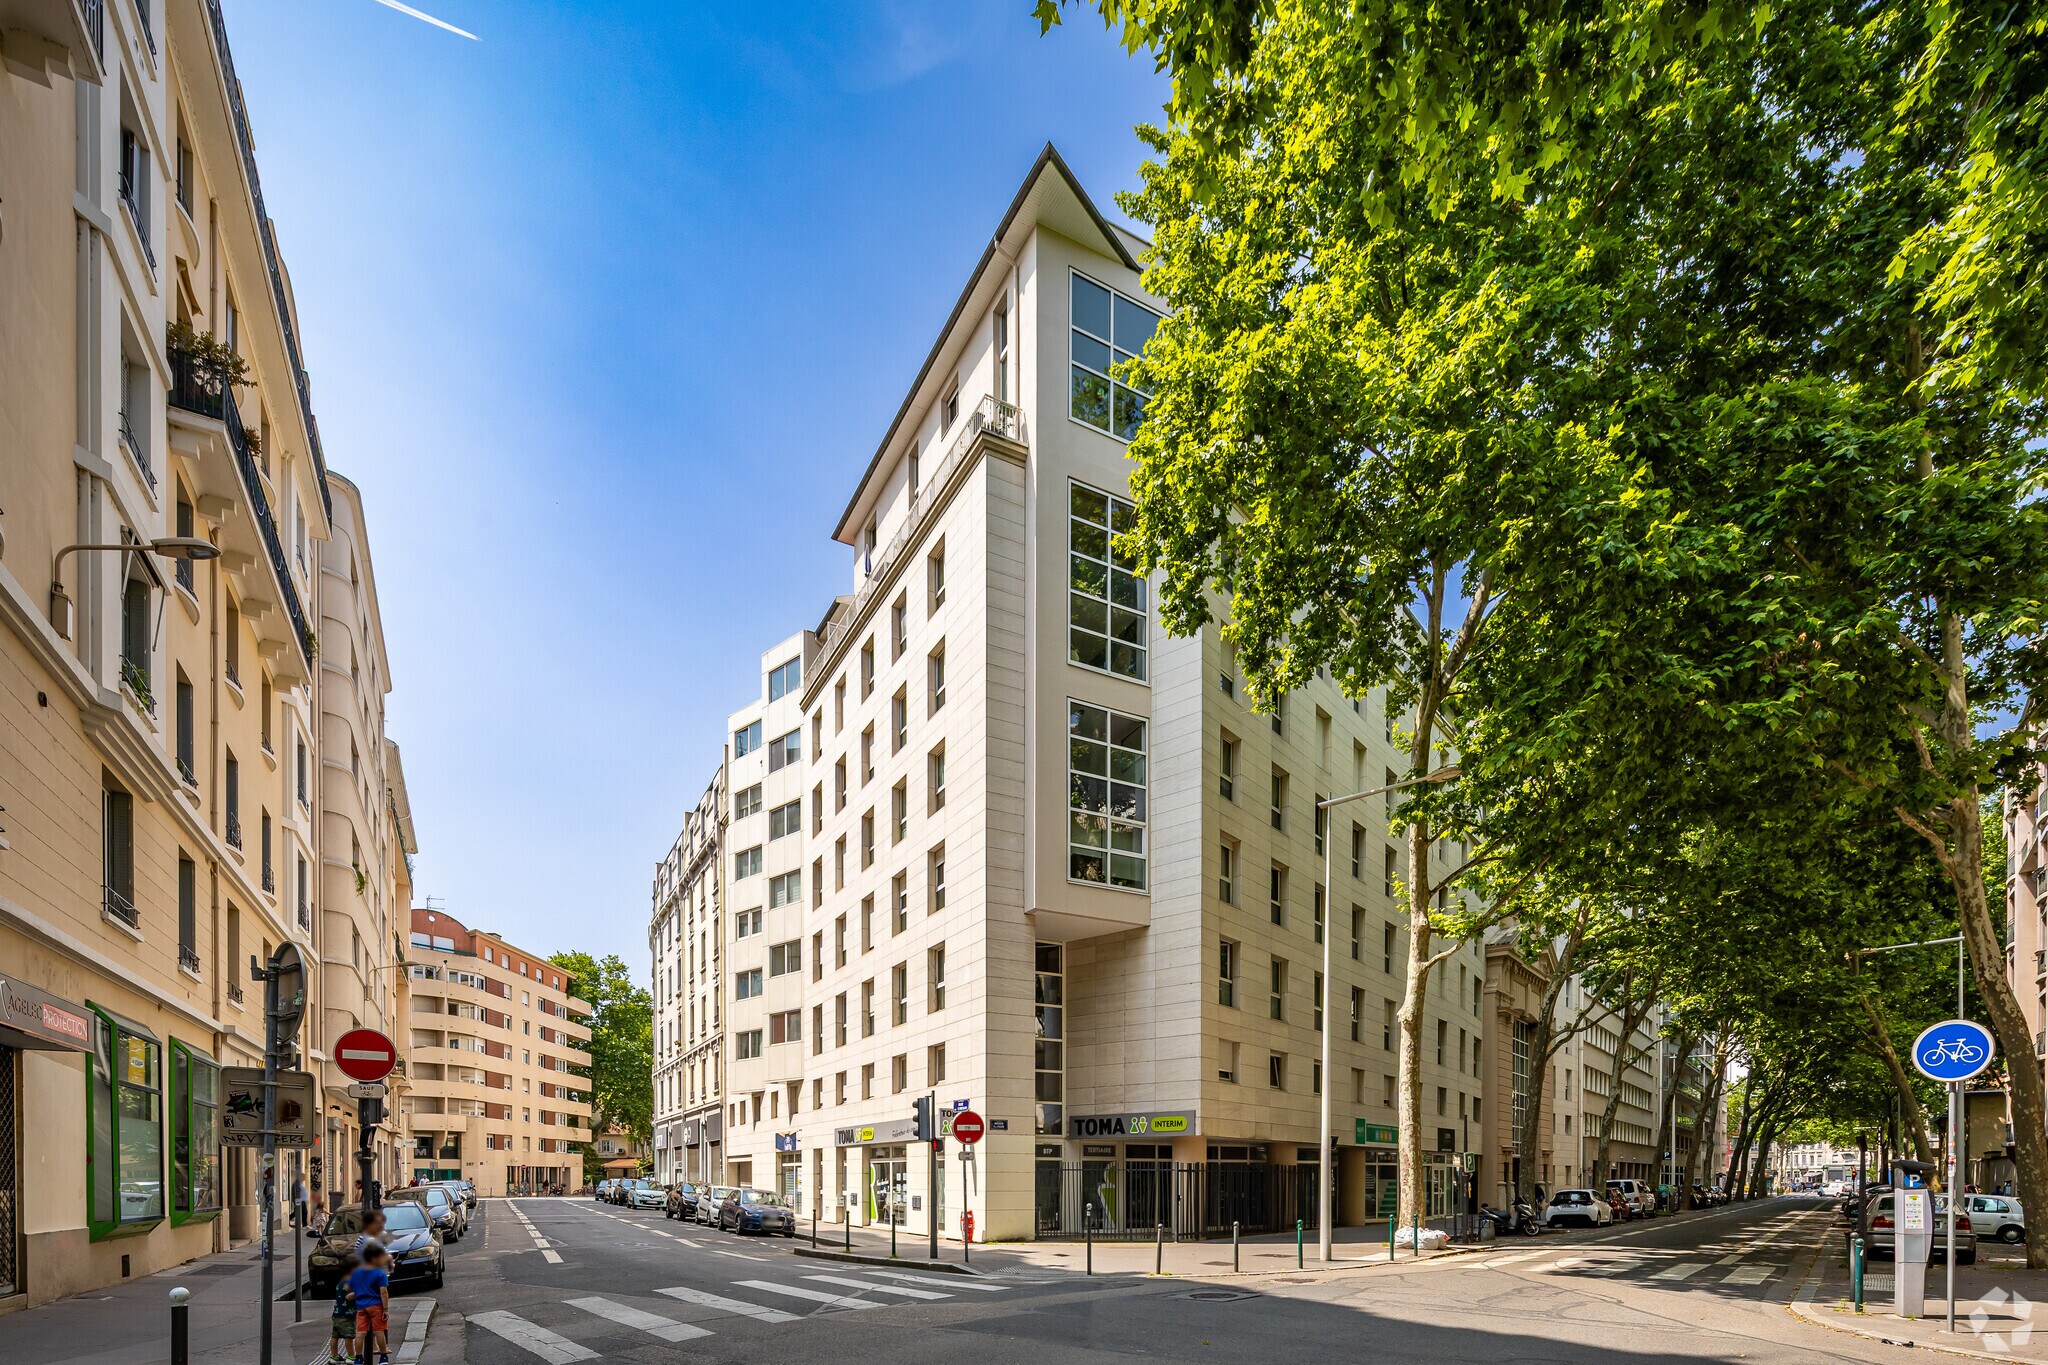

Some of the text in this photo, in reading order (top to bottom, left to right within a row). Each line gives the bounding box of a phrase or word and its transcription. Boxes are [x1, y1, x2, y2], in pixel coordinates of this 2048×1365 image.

[8, 995, 88, 1039] AGELEC PROTECTION
[1074, 1117, 1184, 1136] TOMA INTERIM
[838, 1129, 855, 1144] TOMA
[1466, 1155, 1473, 1168] P
[1909, 1174, 1920, 1187] P
